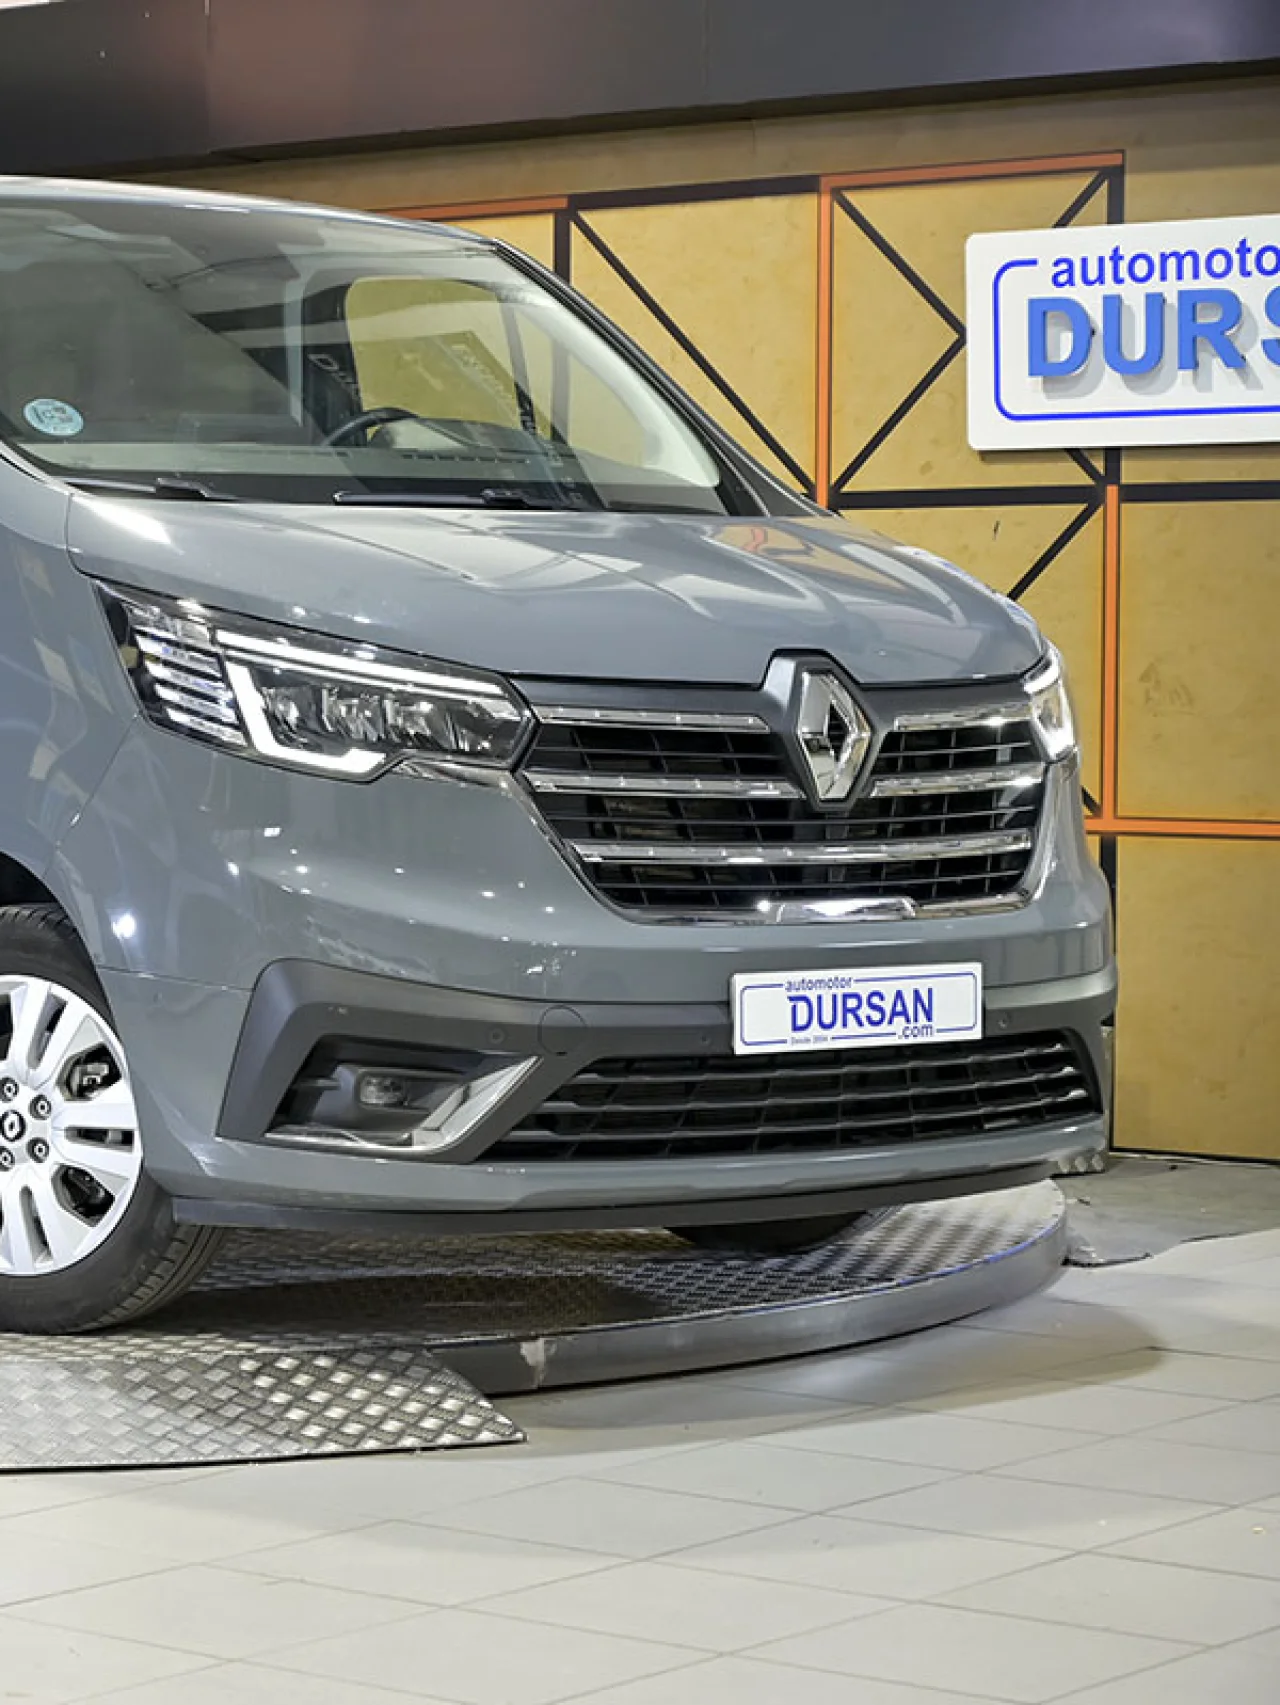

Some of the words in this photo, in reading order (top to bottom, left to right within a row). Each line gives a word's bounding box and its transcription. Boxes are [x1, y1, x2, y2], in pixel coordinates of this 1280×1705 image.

[1027, 285, 1280, 377] DUR
[785, 976, 852, 993] automotor
[787, 987, 933, 1032] DURSAN
[898, 1021, 933, 1040] .com
